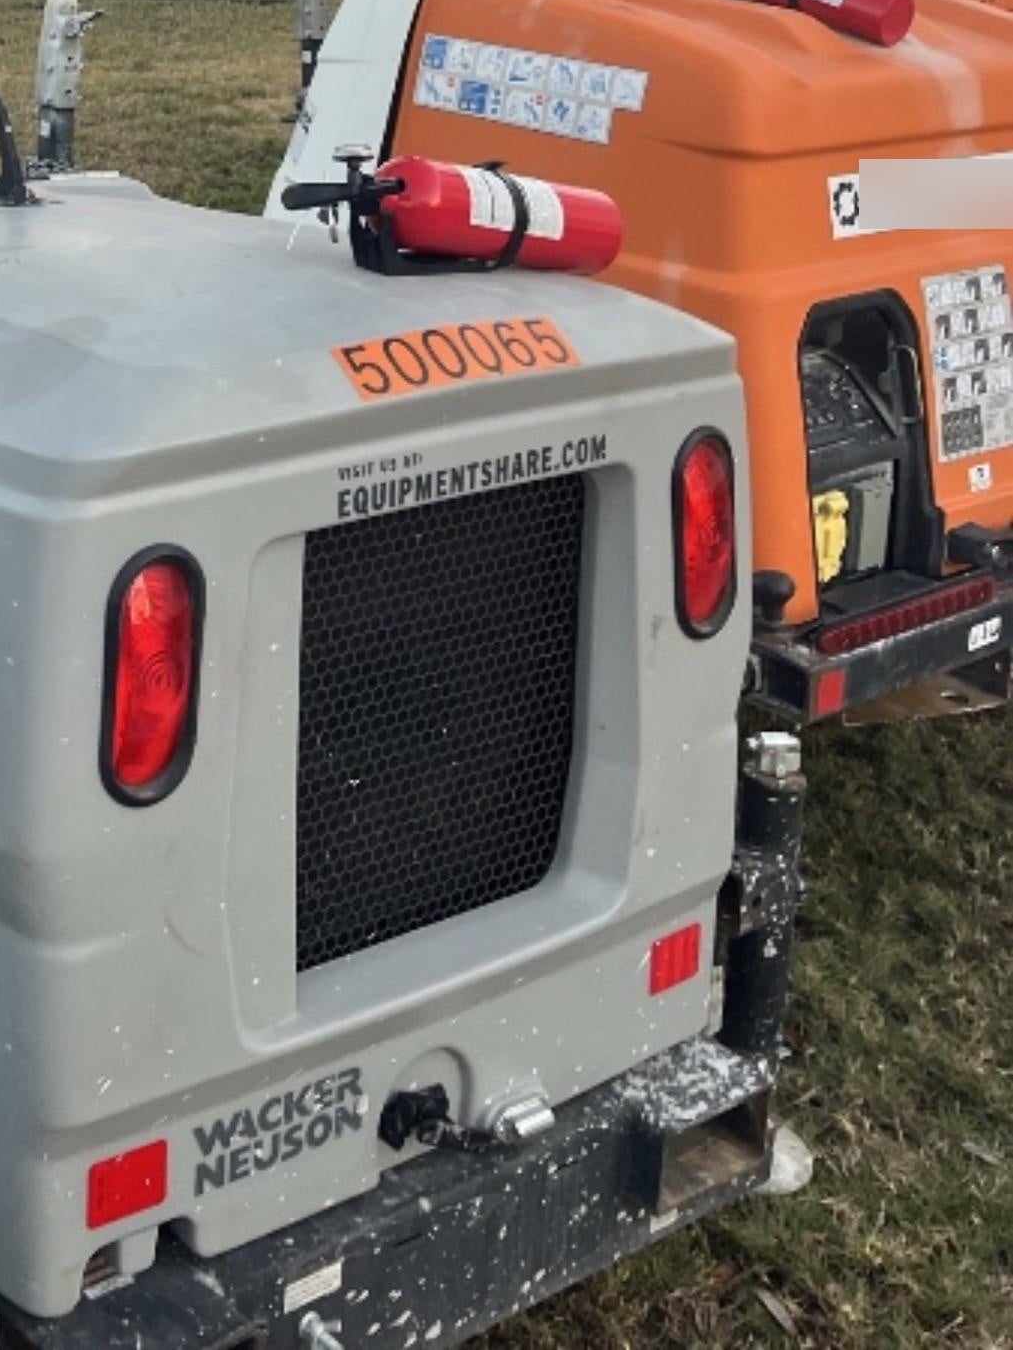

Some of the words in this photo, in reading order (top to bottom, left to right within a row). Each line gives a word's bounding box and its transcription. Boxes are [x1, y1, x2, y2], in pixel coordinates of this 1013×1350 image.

[339, 319, 569, 394] 500065
[337, 434, 608, 518] EQUIPMENTSHARE.COM
[192, 1066, 364, 1157] WACKER
[193, 1106, 364, 1198] NEUSON
